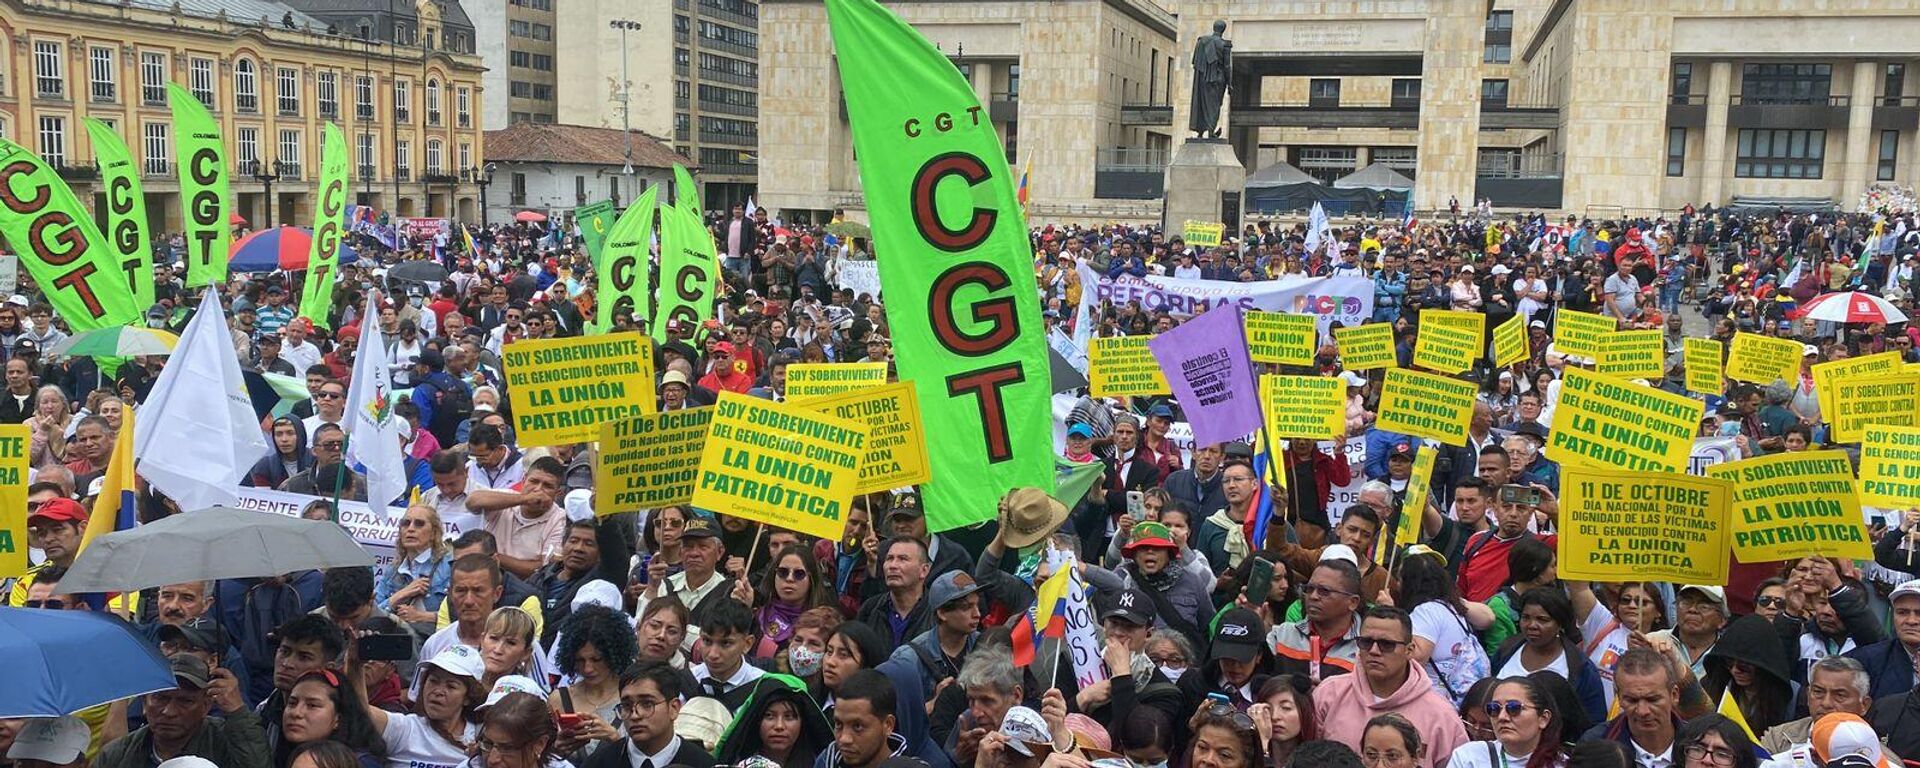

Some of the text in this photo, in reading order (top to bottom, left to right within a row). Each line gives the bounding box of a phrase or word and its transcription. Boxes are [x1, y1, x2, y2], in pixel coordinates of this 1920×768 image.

[190, 148, 221, 266] CGT
[0, 160, 108, 320] CGT
[111, 176, 142, 295] CGT
[314, 179, 342, 299] CGT
[910, 151, 1027, 465] CGT
[1247, 312, 1315, 324] SOY SOBREVIVIENTE
[1254, 331, 1305, 345] LA UNIÓN
[1563, 330, 1573, 338] LA
[506, 340, 639, 368] SOY SOBREVIVIENTE
[1097, 339, 1120, 350] 11 De
[1347, 342, 1386, 354] LA UNIÓN
[1424, 342, 1466, 358] LA UNIÓN
[1343, 353, 1393, 364] PATRIÓTICA
[1417, 351, 1470, 369] PATRIÓTICA
[1599, 362, 1660, 373] PATRIÓTICA
[1605, 354, 1618, 362] LA
[1850, 359, 1892, 375] OCTUBRE
[510, 361, 640, 386] DEL GENOCIDIO CONTRA
[788, 368, 885, 382] SOY SOBREVIVIENTE
[1108, 373, 1153, 383] LA UNIÓN
[1280, 377, 1338, 389] De Octubre
[529, 380, 626, 408] LA UNIÓN
[788, 386, 801, 396] DEL
[1102, 382, 1159, 393] PATRIÓTICA
[1387, 371, 1477, 398] SOY SOBREVIVIENTE
[1840, 382, 1915, 399] SOY SOBREVIVIENTE
[1385, 384, 1472, 408] DEL GENOCIDIO CONTRA
[1565, 374, 1699, 423] SOY SOBREVIVIENTE
[836, 396, 901, 419] OCTUBRE
[1393, 397, 1459, 420] LA UNIÓN
[1562, 393, 1691, 441] DEL GENOCIDIO CONTRA
[1840, 402, 1852, 415] DEL
[519, 404, 643, 432] PATRIÓTICA
[613, 422, 628, 437] 11
[632, 417, 654, 435] De
[717, 400, 865, 450] SOY SOBREVIVIENTE
[867, 413, 900, 426] POR LA
[1278, 414, 1325, 424] LA UNIÓN
[1381, 410, 1465, 436] PATRIÓTICA
[1841, 418, 1850, 432] LA
[639, 430, 686, 448] Nacional
[688, 429, 705, 442] por
[870, 435, 907, 449] CONTRA
[1572, 414, 1669, 456] LA UNIÓN
[1866, 430, 1888, 443] SOY
[603, 443, 684, 465] Dignidad de las
[712, 423, 857, 470] DEL GENOCIDIO CONTRA
[1865, 447, 1881, 458] DEL
[612, 457, 685, 477] del Genocidio
[722, 447, 833, 491] LA UNIÓN
[1743, 459, 1849, 482] SOBREVIVIENTE
[1878, 463, 1898, 477] LA
[626, 476, 648, 488] LA
[1743, 482, 1808, 501] GENOCIDIO
[1809, 480, 1852, 495] CONTRA
[701, 471, 840, 521] PATRIÓTICA
[1581, 482, 1710, 507] 11 DE OCTUBRE
[341, 510, 380, 527] OTAX
[1572, 511, 1621, 523] DIGNIDAD
[1625, 512, 1638, 524] DE
[1641, 513, 1660, 524] LAS
[1606, 501, 1661, 513] NACIONAL
[1665, 504, 1687, 516] POR
[1691, 506, 1705, 518] LA
[1742, 497, 1843, 524] LA UNIÓN
[1580, 524, 1707, 543] DEL GENOCIDIO CONTRA
[1735, 522, 1863, 548] PATRIÓTICA
[1598, 538, 1620, 550] LA
